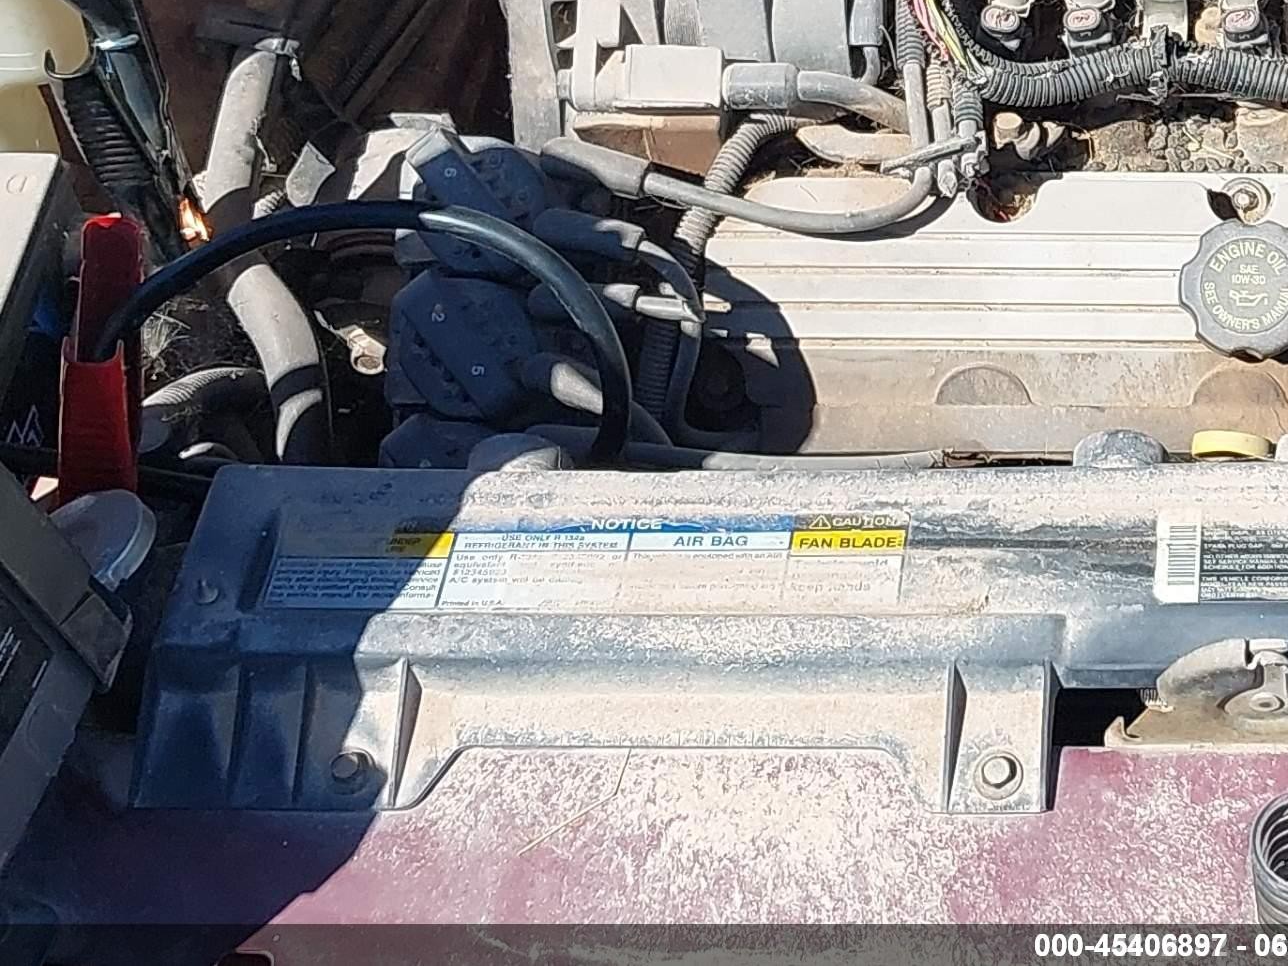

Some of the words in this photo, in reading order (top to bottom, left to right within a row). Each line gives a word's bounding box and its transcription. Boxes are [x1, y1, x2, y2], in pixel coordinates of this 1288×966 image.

[1209, 241, 1266, 273] ENGINE
[1267, 250, 1288, 276] OIL
[1239, 264, 1259, 274] SAE
[1231, 274, 1266, 285] 10W-30
[1203, 281, 1219, 305] SEE
[1212, 304, 1261, 330] OWNER'S
[591, 519, 664, 531] NOTICE
[832, 517, 895, 527] CAUTION
[501, 534, 521, 542] USE
[525, 534, 550, 542] ONLY
[673, 536, 704, 547] AIR
[710, 536, 748, 547] BAG
[799, 537, 833, 549] FAN
[839, 537, 897, 549] BLADE
[456, 553, 471, 561] Use
[482, 554, 502, 563] only
